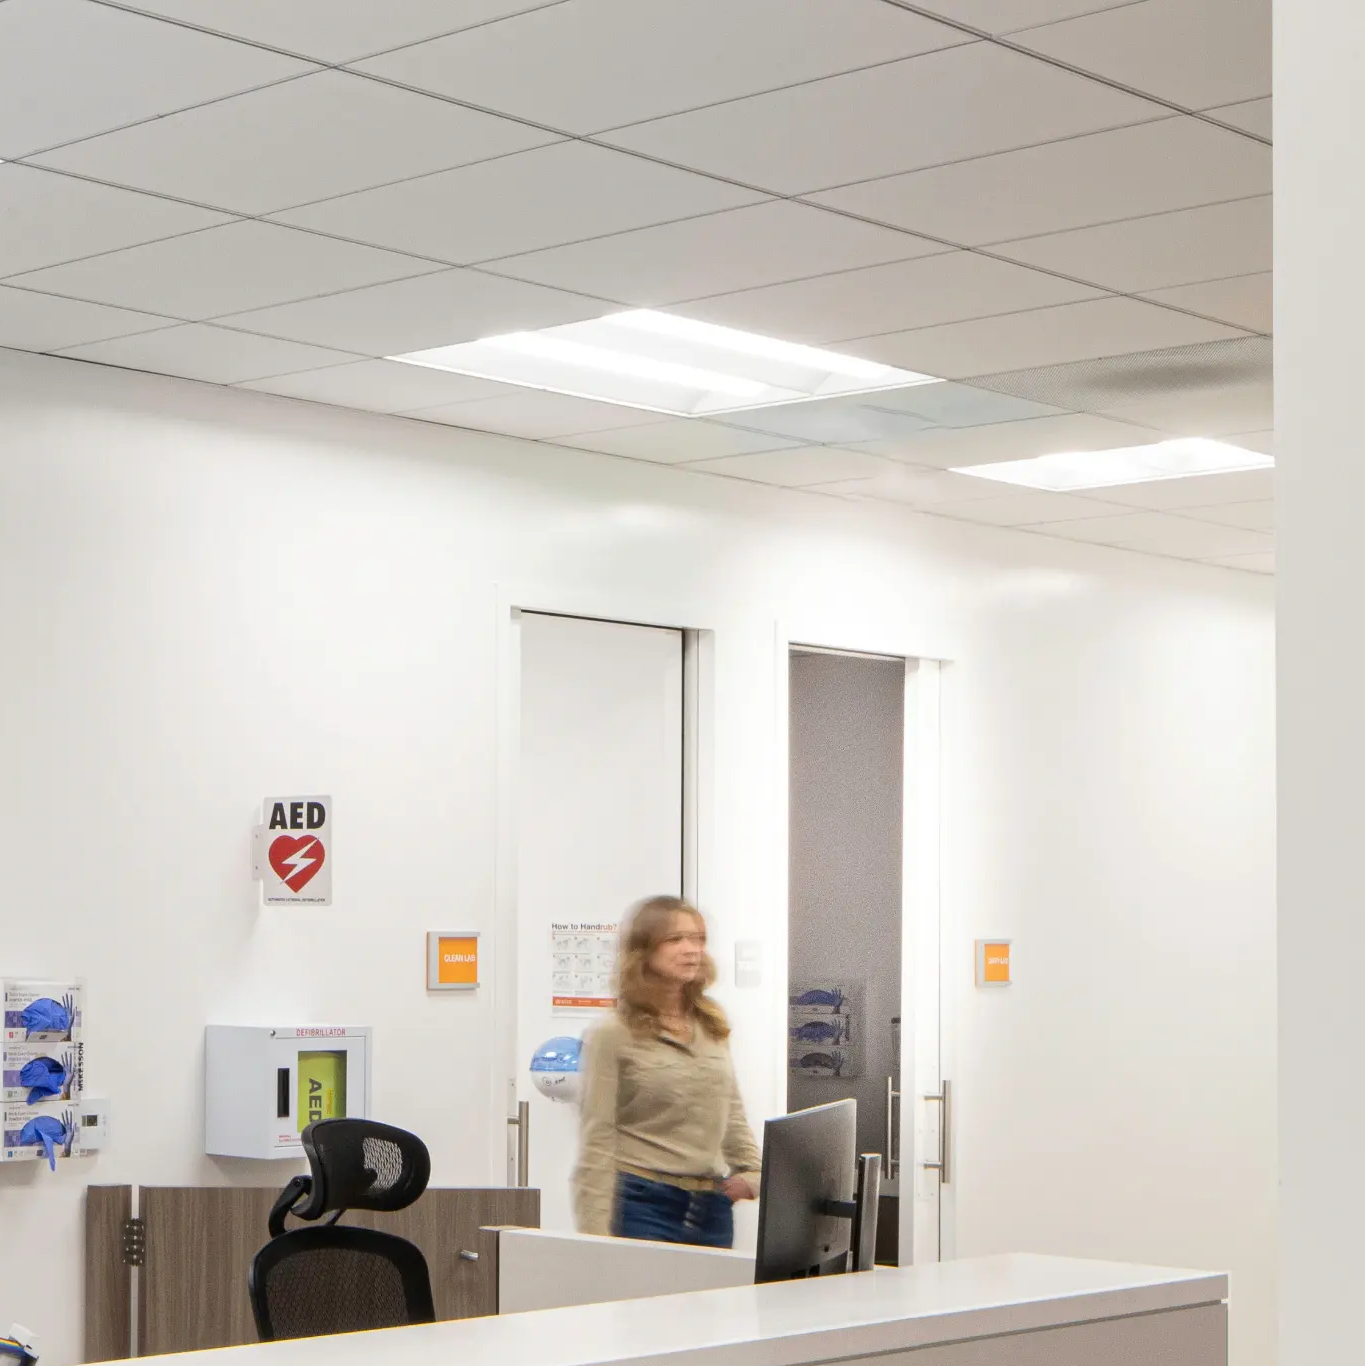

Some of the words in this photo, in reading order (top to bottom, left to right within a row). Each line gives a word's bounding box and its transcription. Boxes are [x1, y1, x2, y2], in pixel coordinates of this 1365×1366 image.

[268, 802, 326, 830] AED
[580, 923, 618, 931] Handrub?
[443, 953, 464, 963] CLEAN
[464, 953, 476, 963] LAB
[296, 1028, 346, 1037] DEFIBRILLATOR
[308, 1078, 322, 1123] AED
